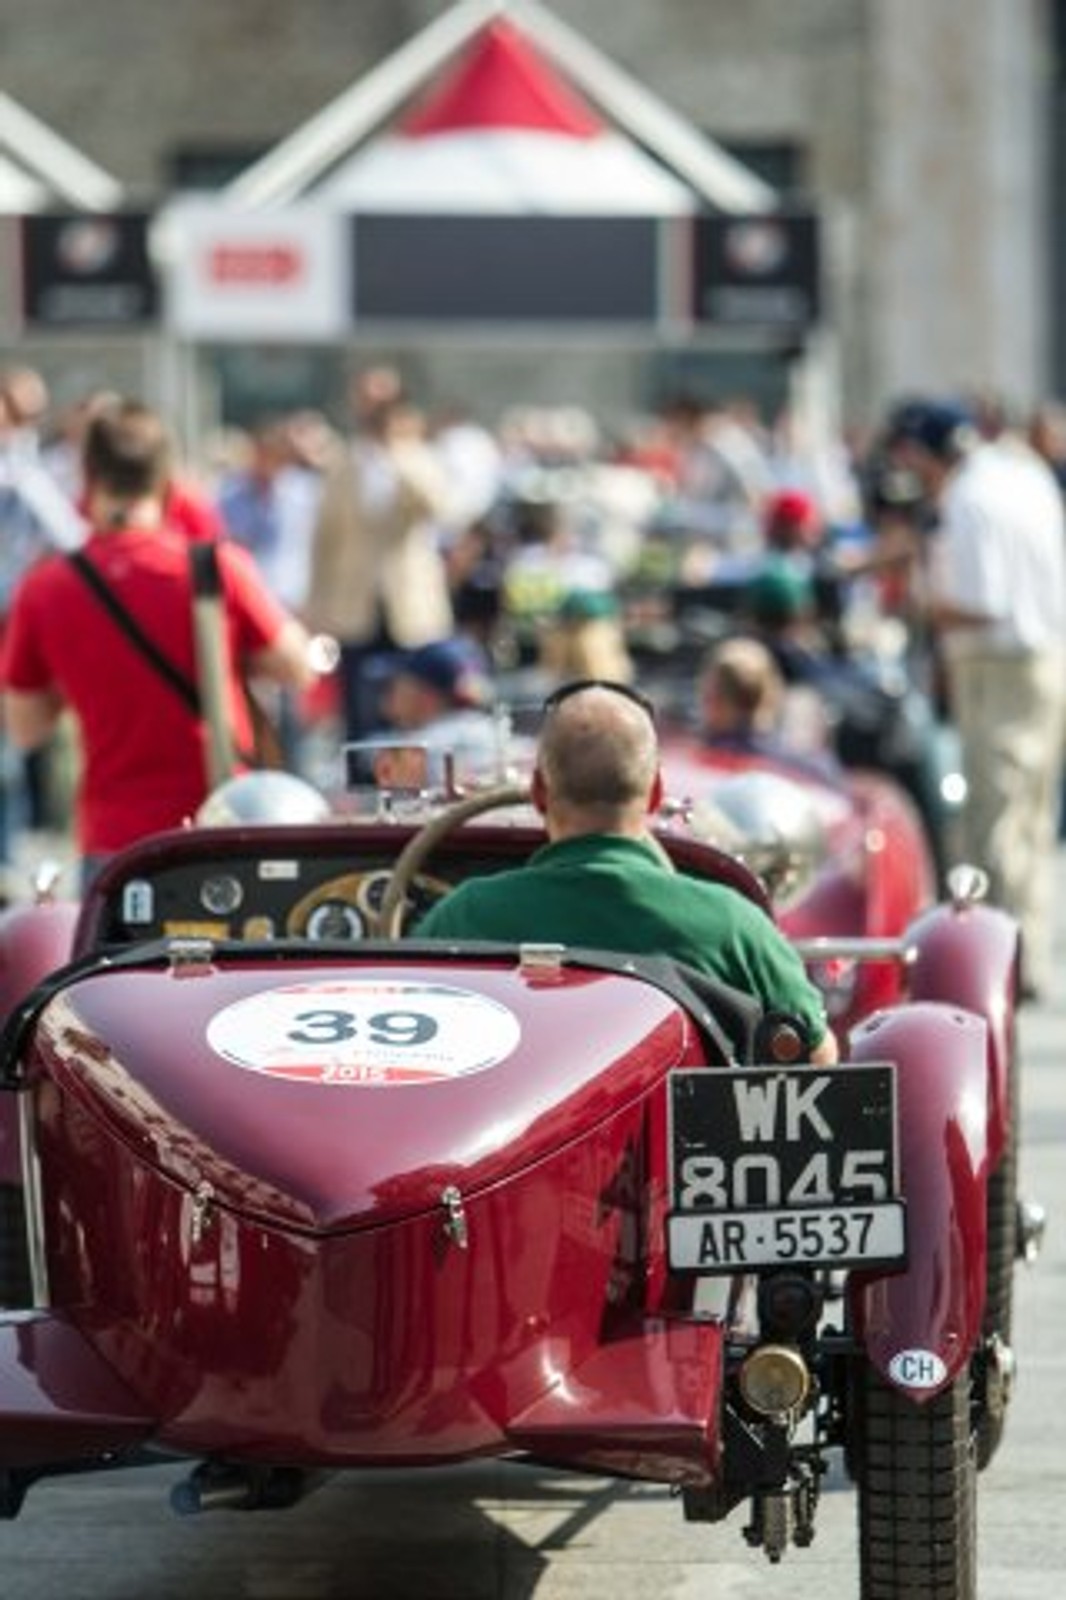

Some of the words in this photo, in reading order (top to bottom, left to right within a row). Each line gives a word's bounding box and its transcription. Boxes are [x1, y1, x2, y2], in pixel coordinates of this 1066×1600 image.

[287, 1010, 438, 1046] 39
[733, 1076, 834, 1142] WK
[900, 1357, 934, 1381] CH
